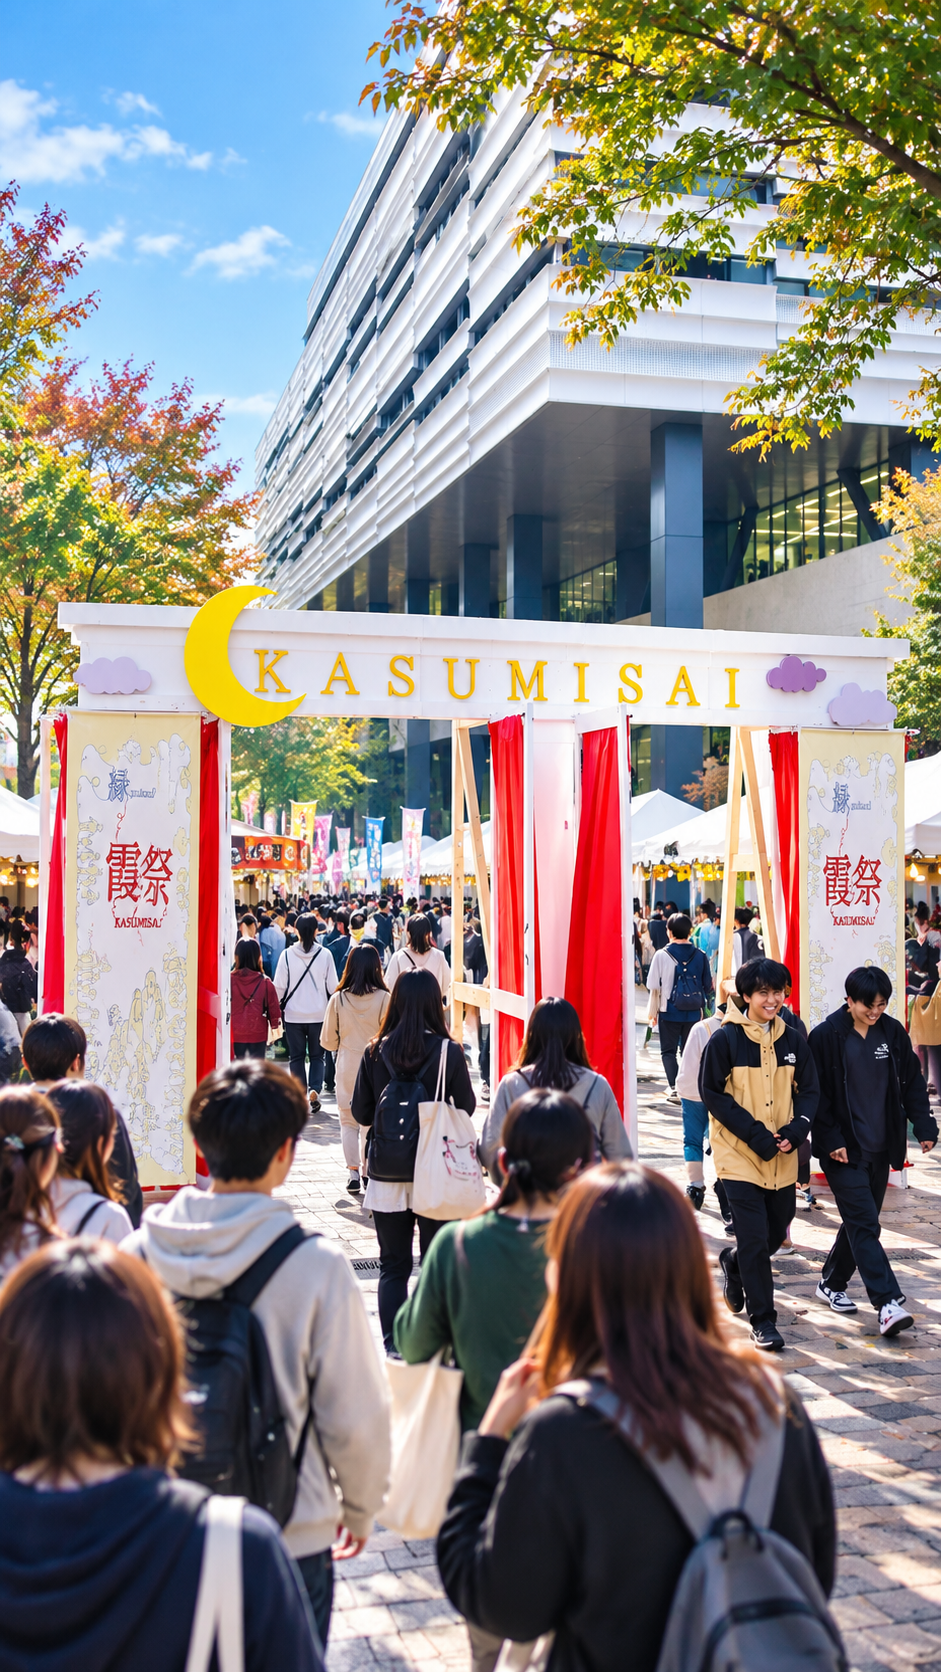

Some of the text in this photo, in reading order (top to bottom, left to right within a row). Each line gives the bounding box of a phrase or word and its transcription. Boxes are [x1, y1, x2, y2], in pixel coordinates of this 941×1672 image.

[254, 649, 741, 709] KASUMISAI
[105, 841, 173, 906] 霞祭
[823, 854, 882, 907] 霞祭
